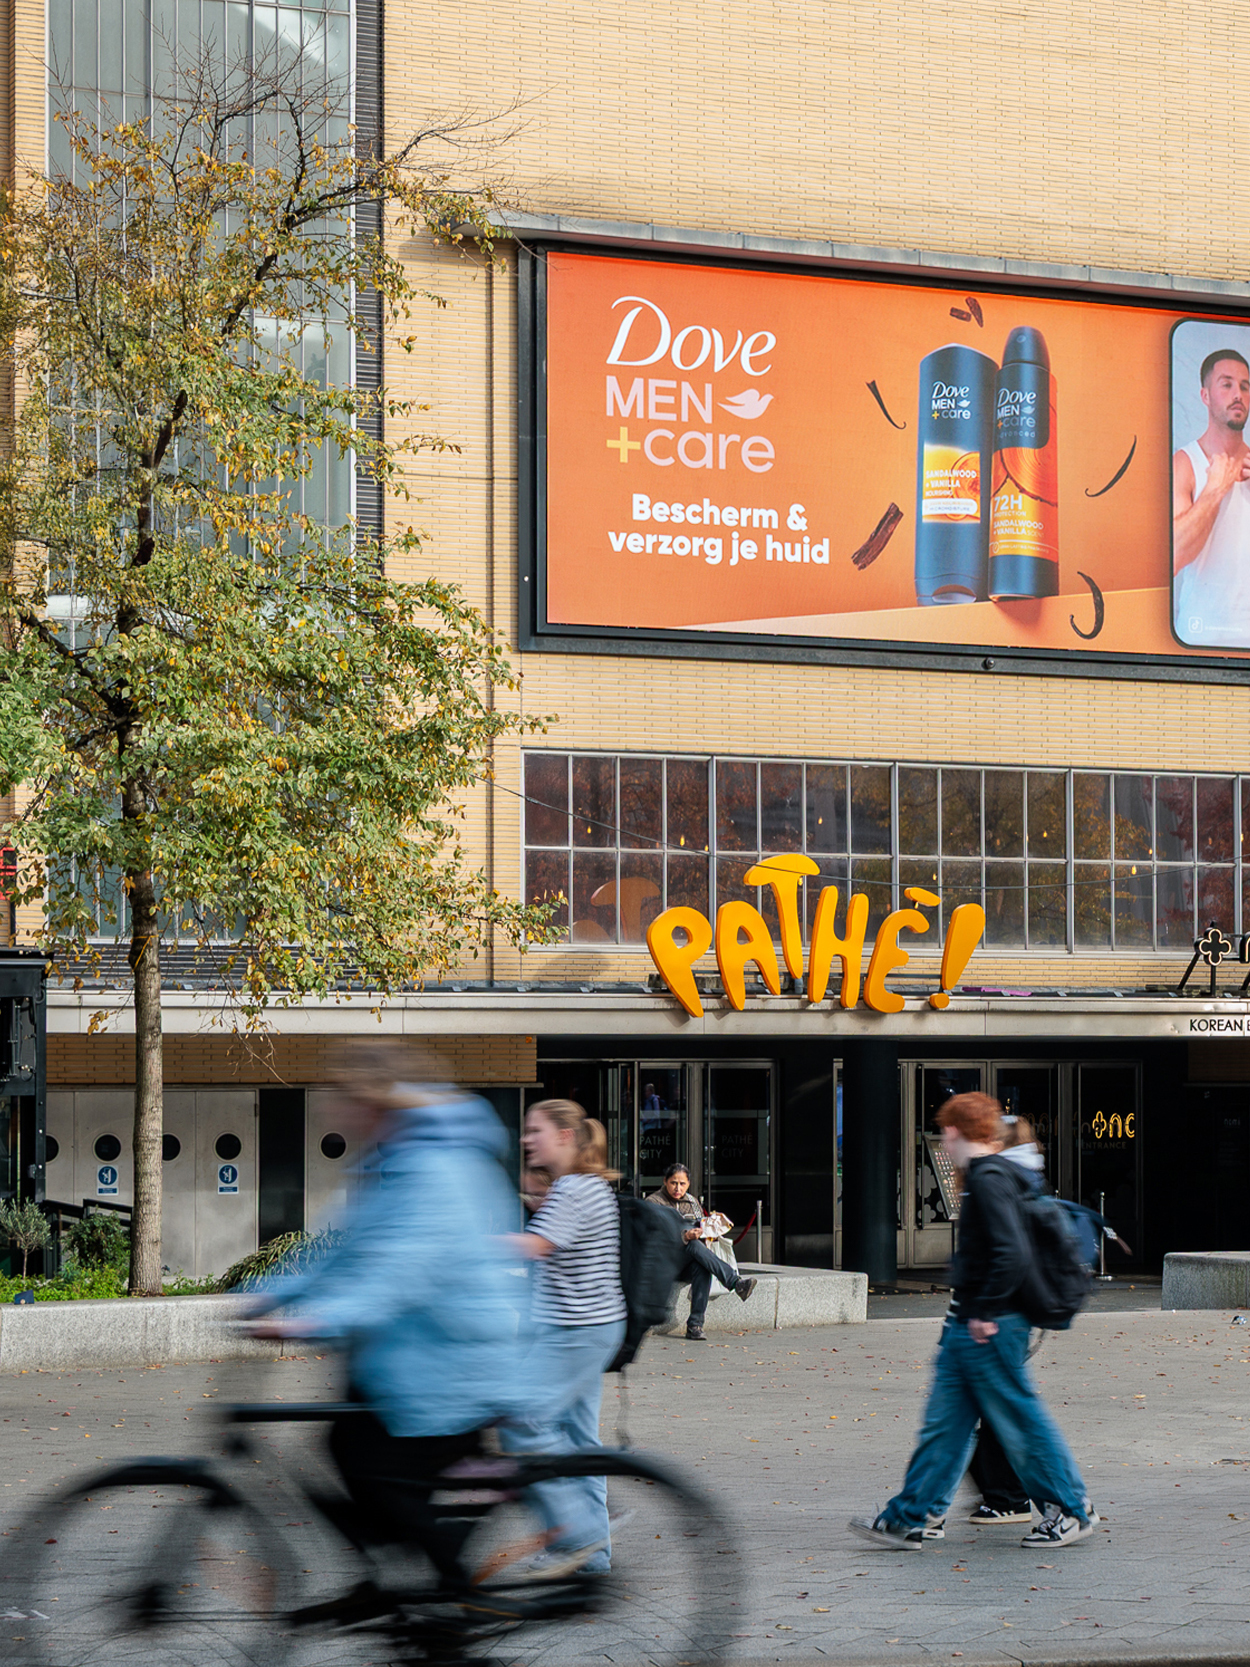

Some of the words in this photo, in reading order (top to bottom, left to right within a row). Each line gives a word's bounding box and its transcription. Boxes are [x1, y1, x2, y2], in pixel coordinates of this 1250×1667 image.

[605, 295, 777, 376] Dove
[932, 381, 970, 399] Dove
[605, 375, 713, 424] MEN
[997, 387, 1036, 408] Dove
[932, 399, 955, 411] MEN
[997, 404, 1020, 420] MEN
[926, 469, 977, 479] SANDALWOOD
[930, 479, 960, 488] VANILLA
[994, 494, 1023, 512] 72H
[632, 493, 779, 530] Bescherm
[786, 502, 809, 532] &
[993, 519, 1044, 530] SANDALWOOD
[996, 528, 1027, 536] VANILLA
[608, 530, 723, 565] verzorg
[727, 532, 759, 566] je
[765, 534, 830, 565] huid
[1189, 1018, 1243, 1032] KOREAN
[639, 1133, 672, 1146] PATHÉ
[722, 1132, 755, 1145] PATHÉ
[722, 1148, 746, 1159] CITY
